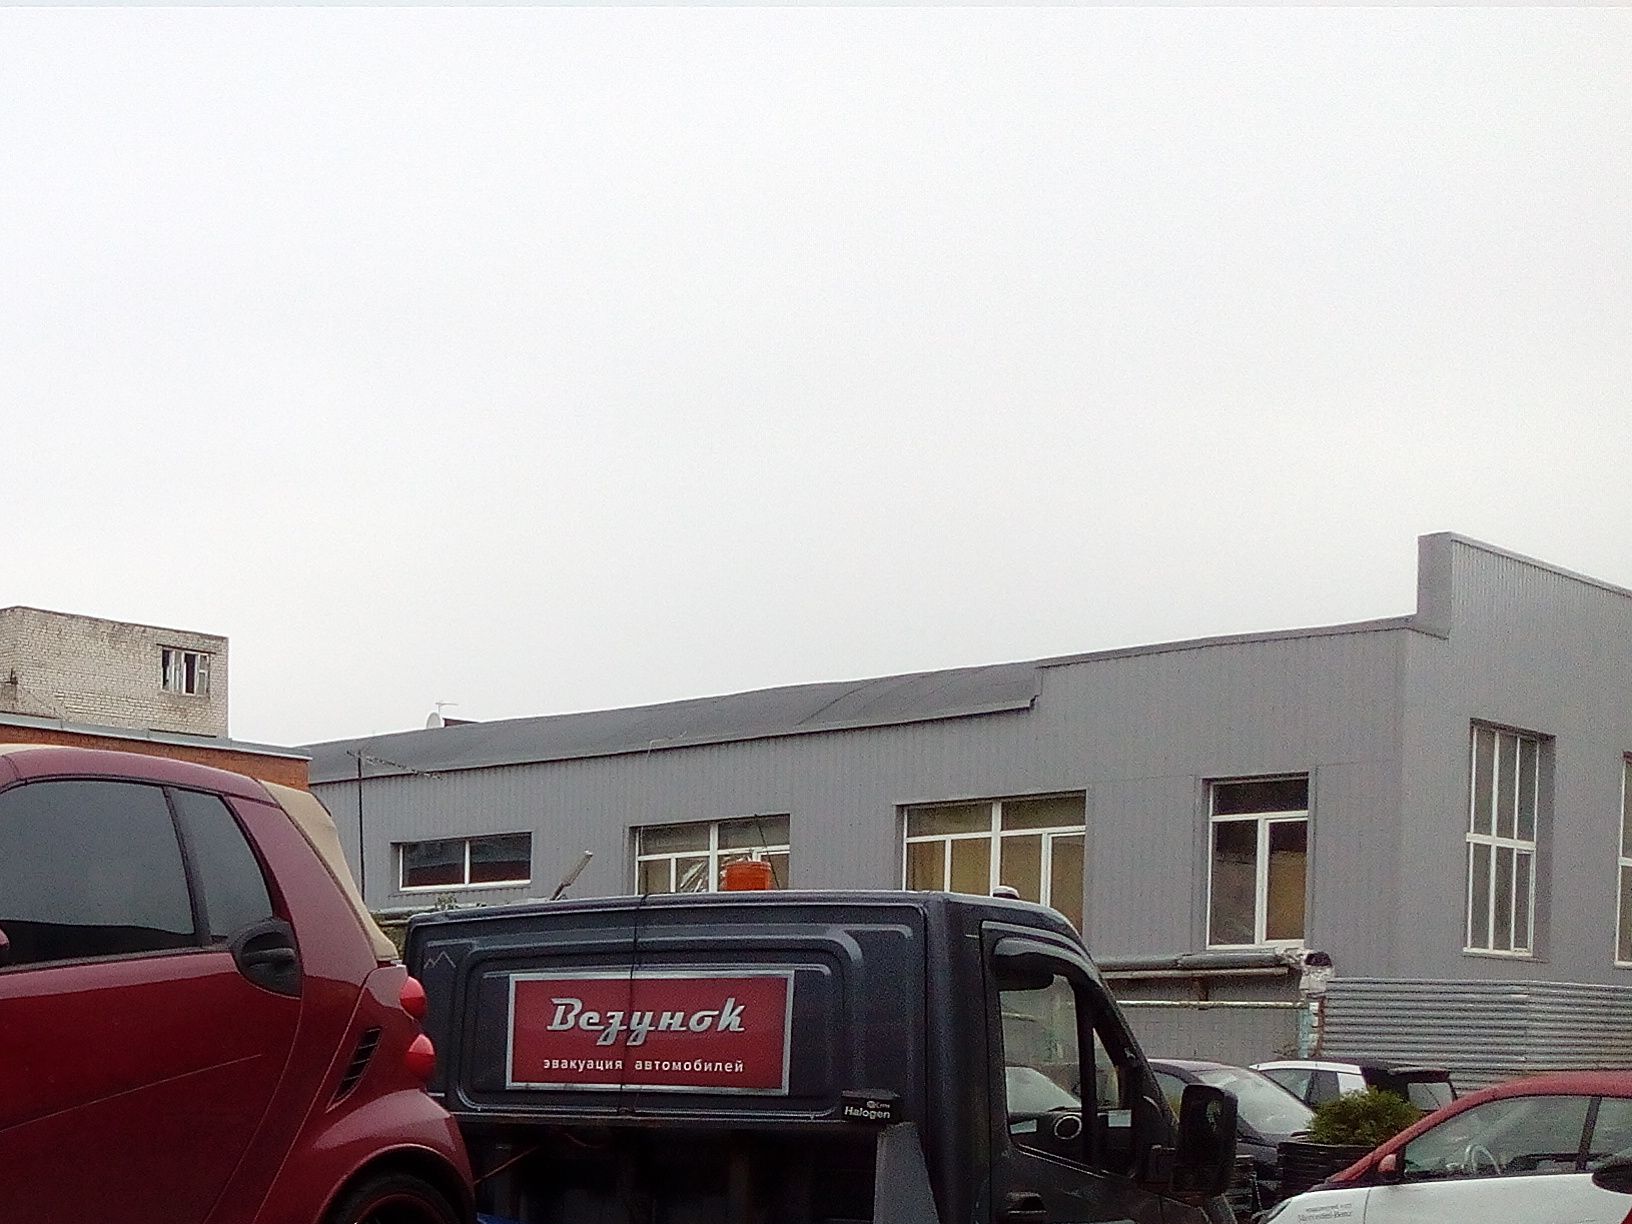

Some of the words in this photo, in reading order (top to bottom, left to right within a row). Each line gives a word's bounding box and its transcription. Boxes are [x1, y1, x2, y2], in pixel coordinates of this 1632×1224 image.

[546, 997, 746, 1047] Везунок
[543, 1059, 623, 1073] эвакуация
[634, 1058, 744, 1073] автомобилей
[844, 1105, 891, 1120] Halogen
